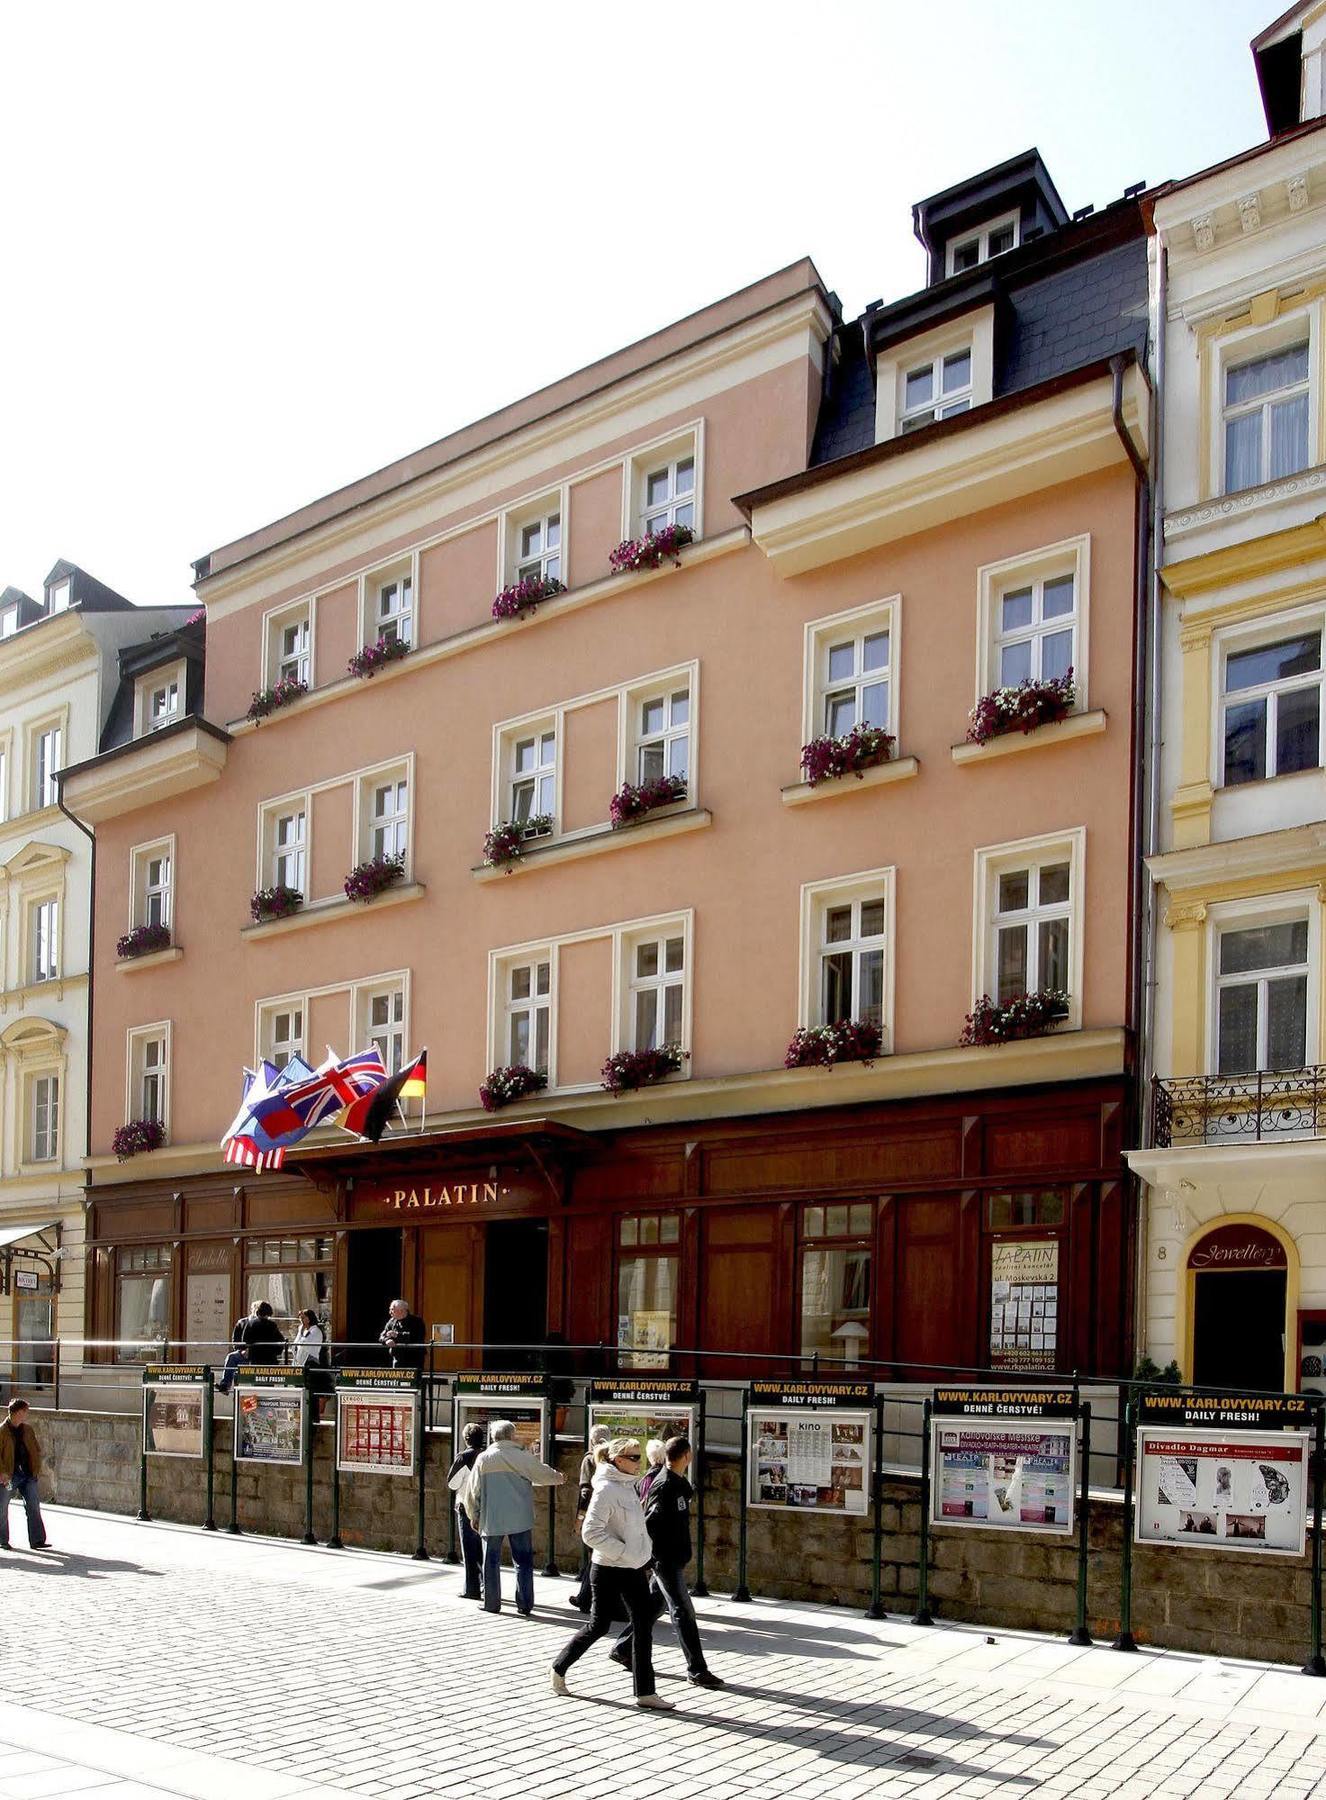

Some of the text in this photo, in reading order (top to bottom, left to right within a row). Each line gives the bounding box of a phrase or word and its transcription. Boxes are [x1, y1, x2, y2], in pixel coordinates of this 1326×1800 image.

[393, 1182, 498, 1209] PALATIN
[1158, 1246, 1167, 1260] 8
[1191, 1244, 1281, 1267] Jewellery
[1049, 1273, 1055, 1281] 2
[990, 1363, 1056, 1372] www.rkpalatin.cz
[342, 1369, 416, 1379] WWW.KARLOVYVARY.CZ
[459, 1374, 544, 1384] WWW.KARLOVYVARY.CZ
[499, 1384, 520, 1392] FRESH!
[593, 1381, 692, 1392] WWW.KARLOVYVARY.CZ
[753, 1383, 868, 1396] WWW.KARLOVYVARY.CZ
[613, 1391, 671, 1401] DENNĚ ČERSTVÉ!
[782, 1396, 837, 1405] DAILY FRESH!
[937, 1391, 1073, 1405] WWW.KARLOVYVARY.CZ
[963, 1403, 1043, 1414] DENNĚ ČERSTVÉ!
[1144, 1397, 1306, 1412] WWW.KARLOVYVARY.CZ
[1185, 1411, 1260, 1422] DAILY FRESH!
[798, 1422, 820, 1431] kino
[1149, 1442, 1186, 1451] Divadlo
[1189, 1444, 1229, 1453] Dagmar
